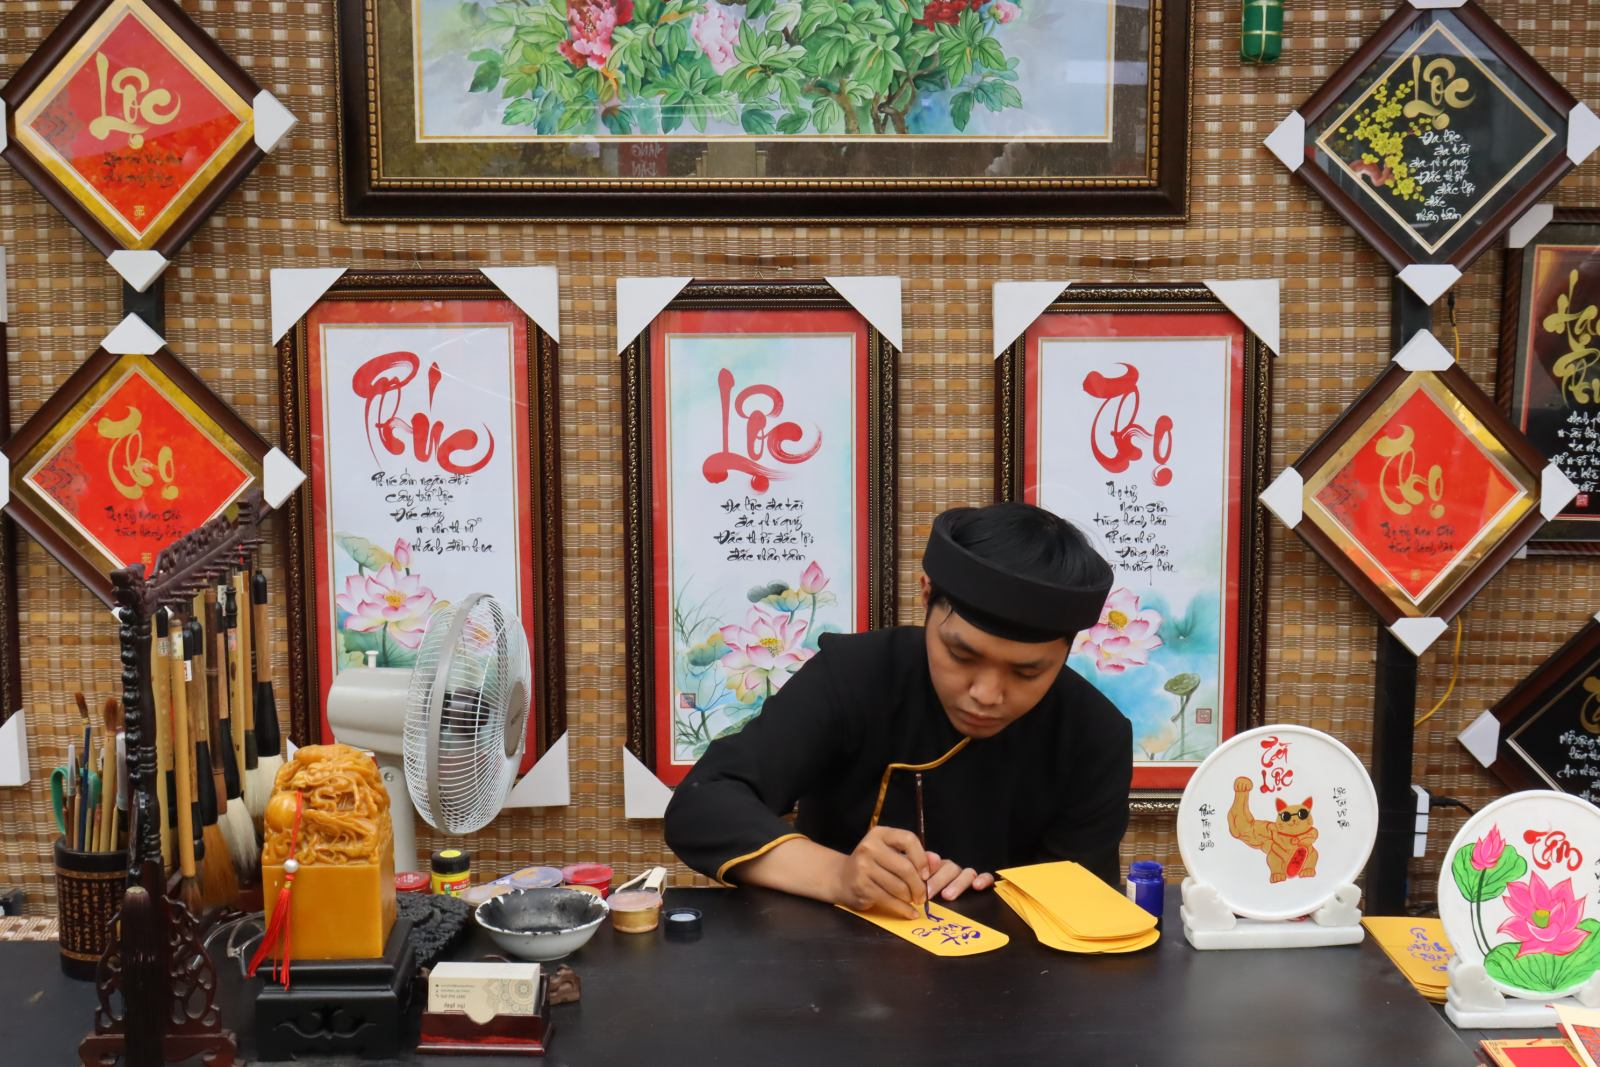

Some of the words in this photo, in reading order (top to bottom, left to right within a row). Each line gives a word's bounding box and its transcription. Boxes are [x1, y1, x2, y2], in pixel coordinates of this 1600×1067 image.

[89, 51, 181, 149] Lộc
[1403, 55, 1476, 130] Lộc
[97, 405, 179, 500] Thọ
[352, 351, 494, 474] Phúc
[702, 368, 823, 494] Lộc
[1083, 362, 1173, 487] Thọ
[1376, 424, 1445, 519] Thọ
[1260, 767, 1294, 793] Lộc
[1523, 829, 1583, 871] Tâm
